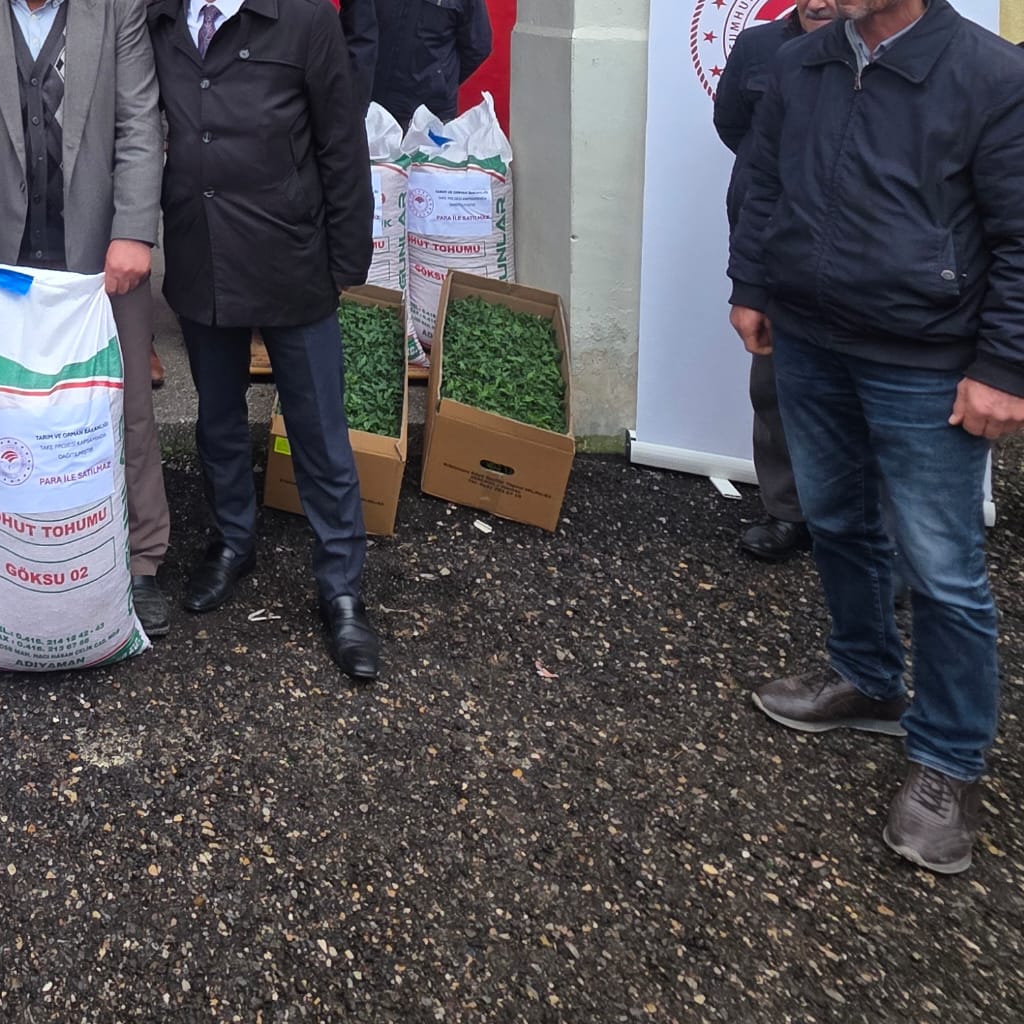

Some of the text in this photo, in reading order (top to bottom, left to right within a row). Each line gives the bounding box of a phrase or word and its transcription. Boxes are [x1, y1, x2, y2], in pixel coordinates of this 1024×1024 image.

[432, 243, 481, 254] TOHUMU
[39, 461, 111, 485] PARA İLE SATILMAZ
[41, 507, 107, 538] TOHUMU
[5, 562, 89, 586] GÖKSU 02
[15, 656, 85, 669] ADIYAMAN
